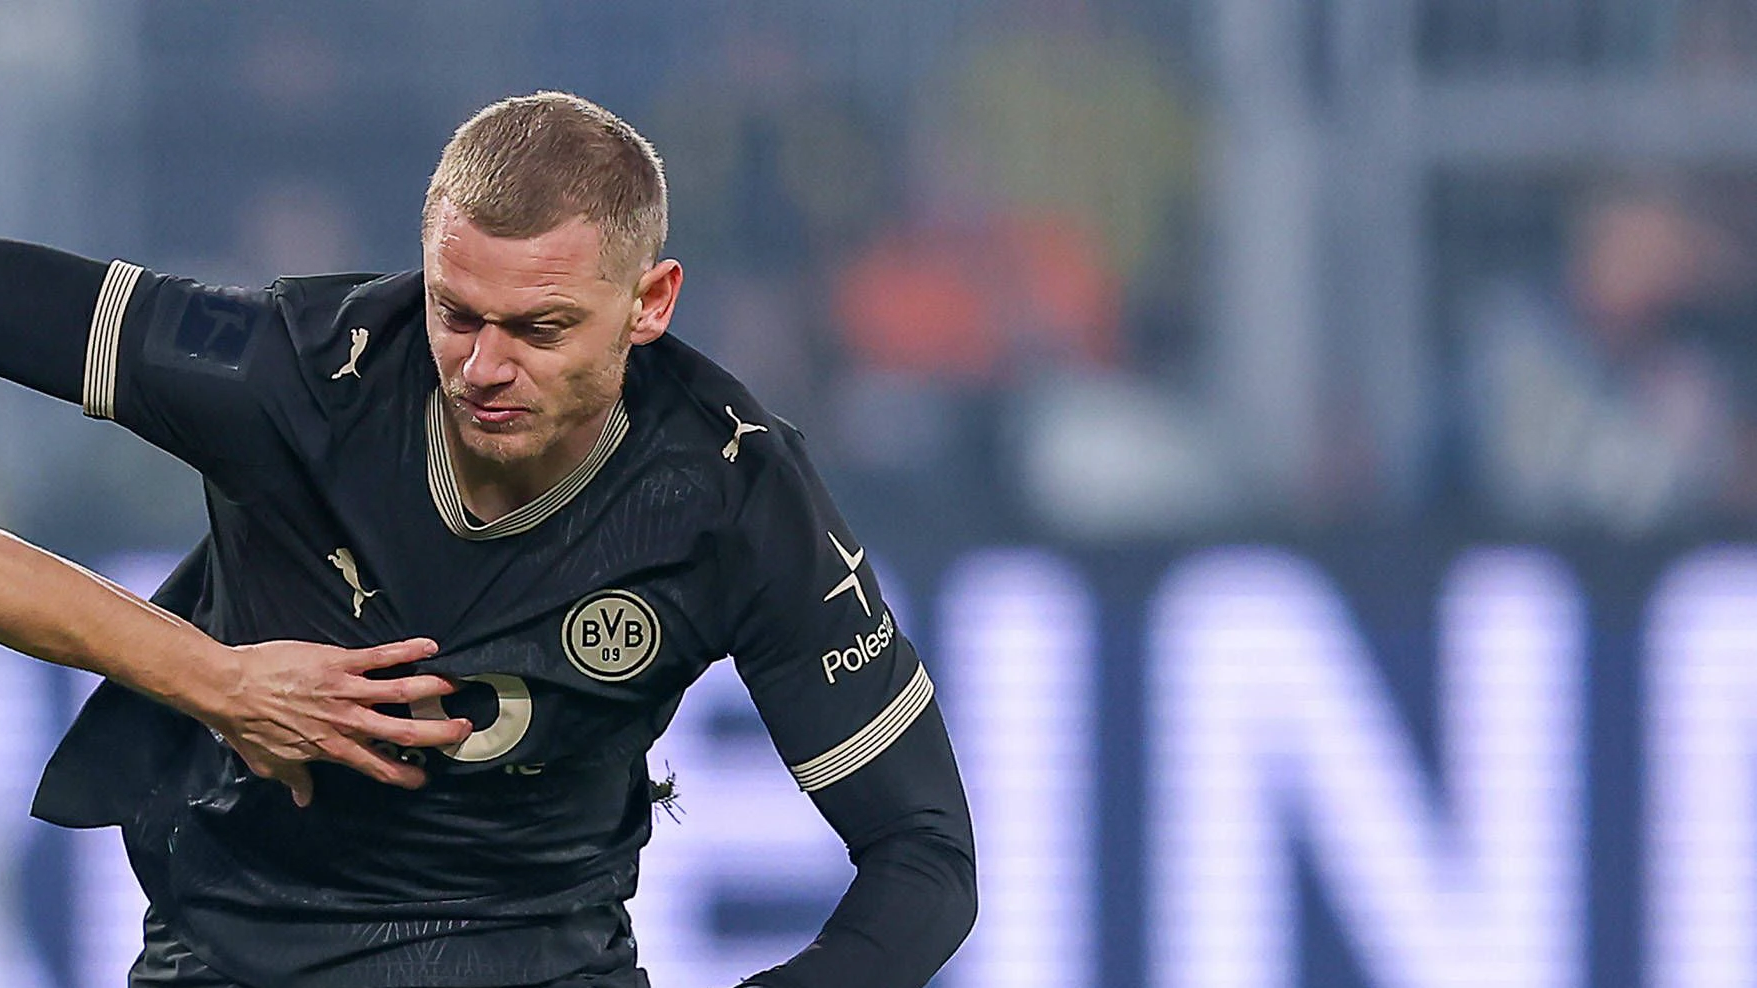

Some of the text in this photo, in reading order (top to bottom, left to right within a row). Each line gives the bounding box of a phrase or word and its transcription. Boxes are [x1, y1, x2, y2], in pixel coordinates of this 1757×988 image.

[582, 608, 644, 649] BVB
[822, 610, 894, 684] Polest
[601, 647, 621, 662] 09
